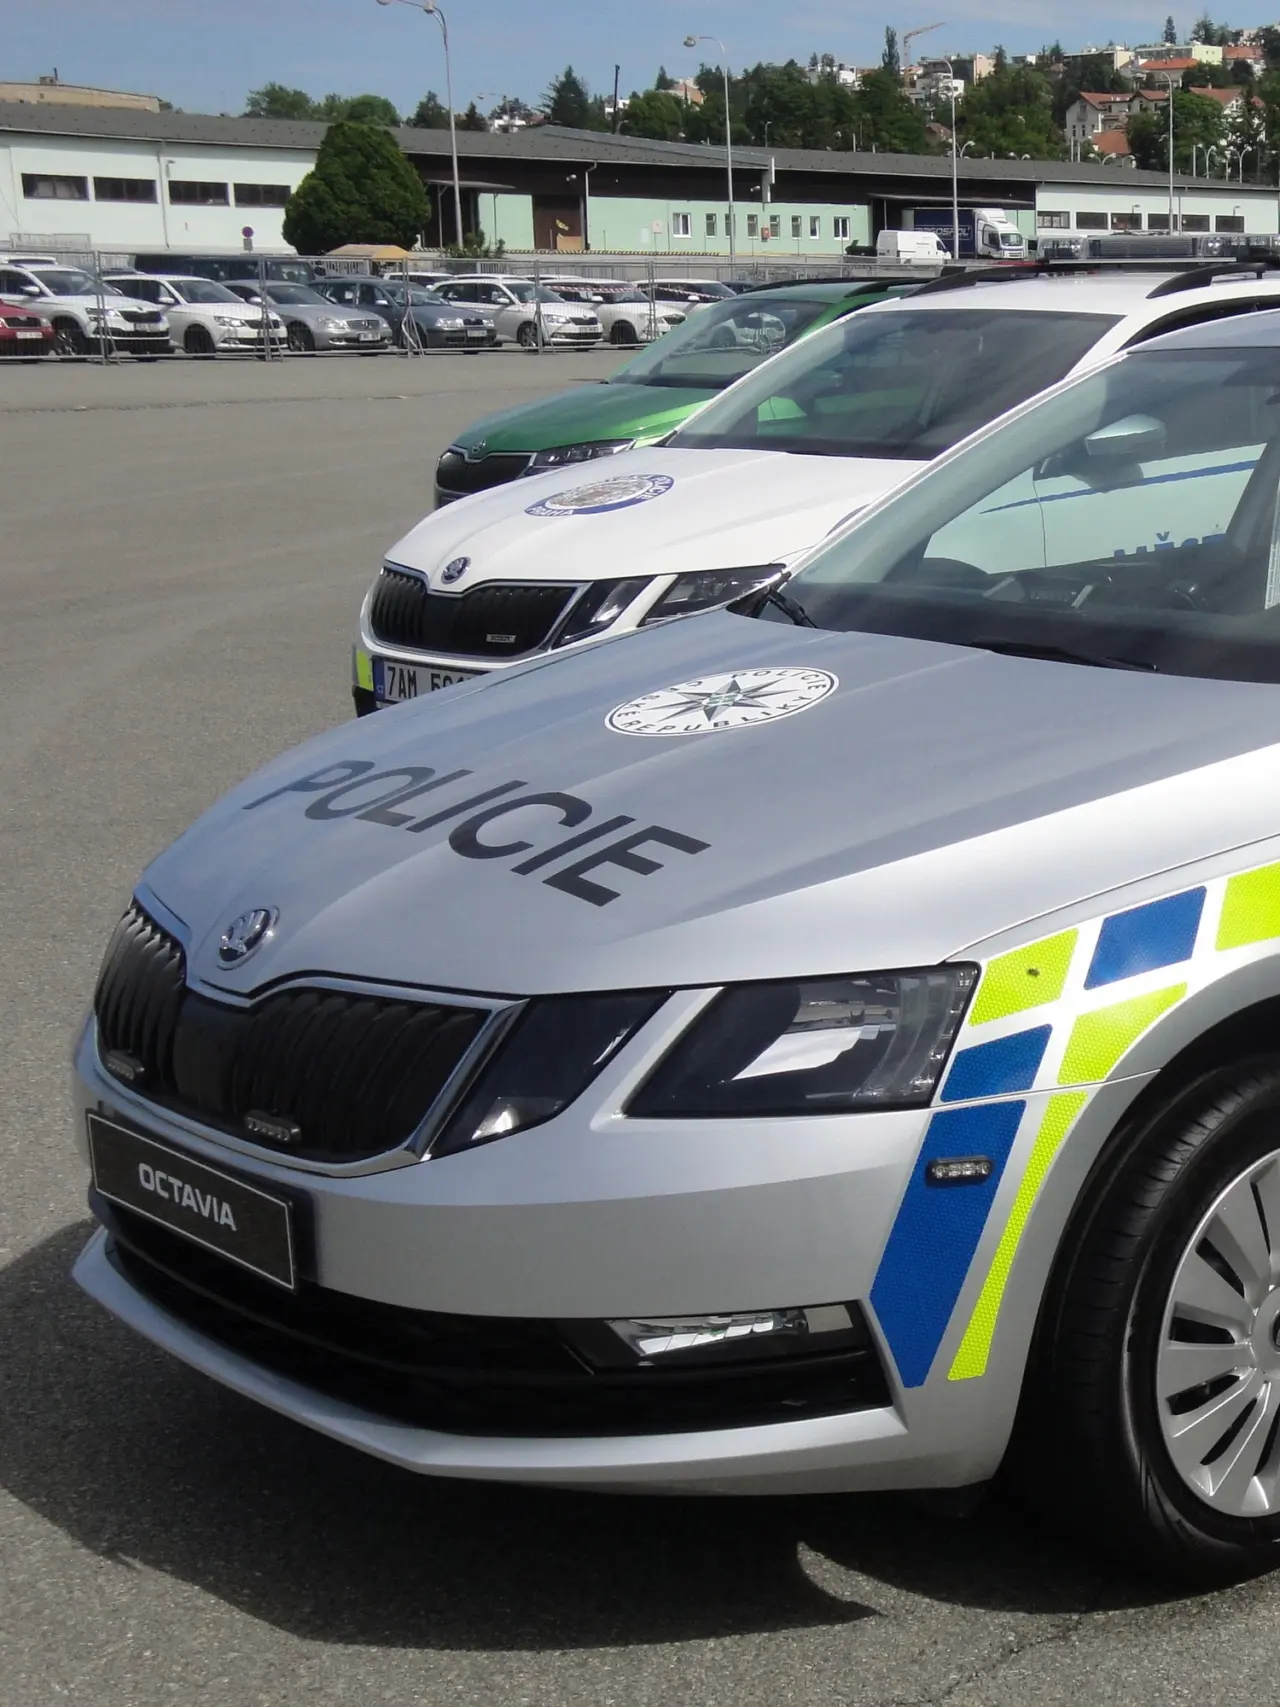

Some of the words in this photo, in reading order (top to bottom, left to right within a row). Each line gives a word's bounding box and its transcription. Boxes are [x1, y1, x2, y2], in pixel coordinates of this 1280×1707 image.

[387, 665, 418, 699] 7AM
[730, 669, 828, 692] POLICIE
[616, 694, 814, 733] REPUBLIKY
[241, 759, 712, 908] POLICIE
[137, 1162, 237, 1232] OCTAVIA
